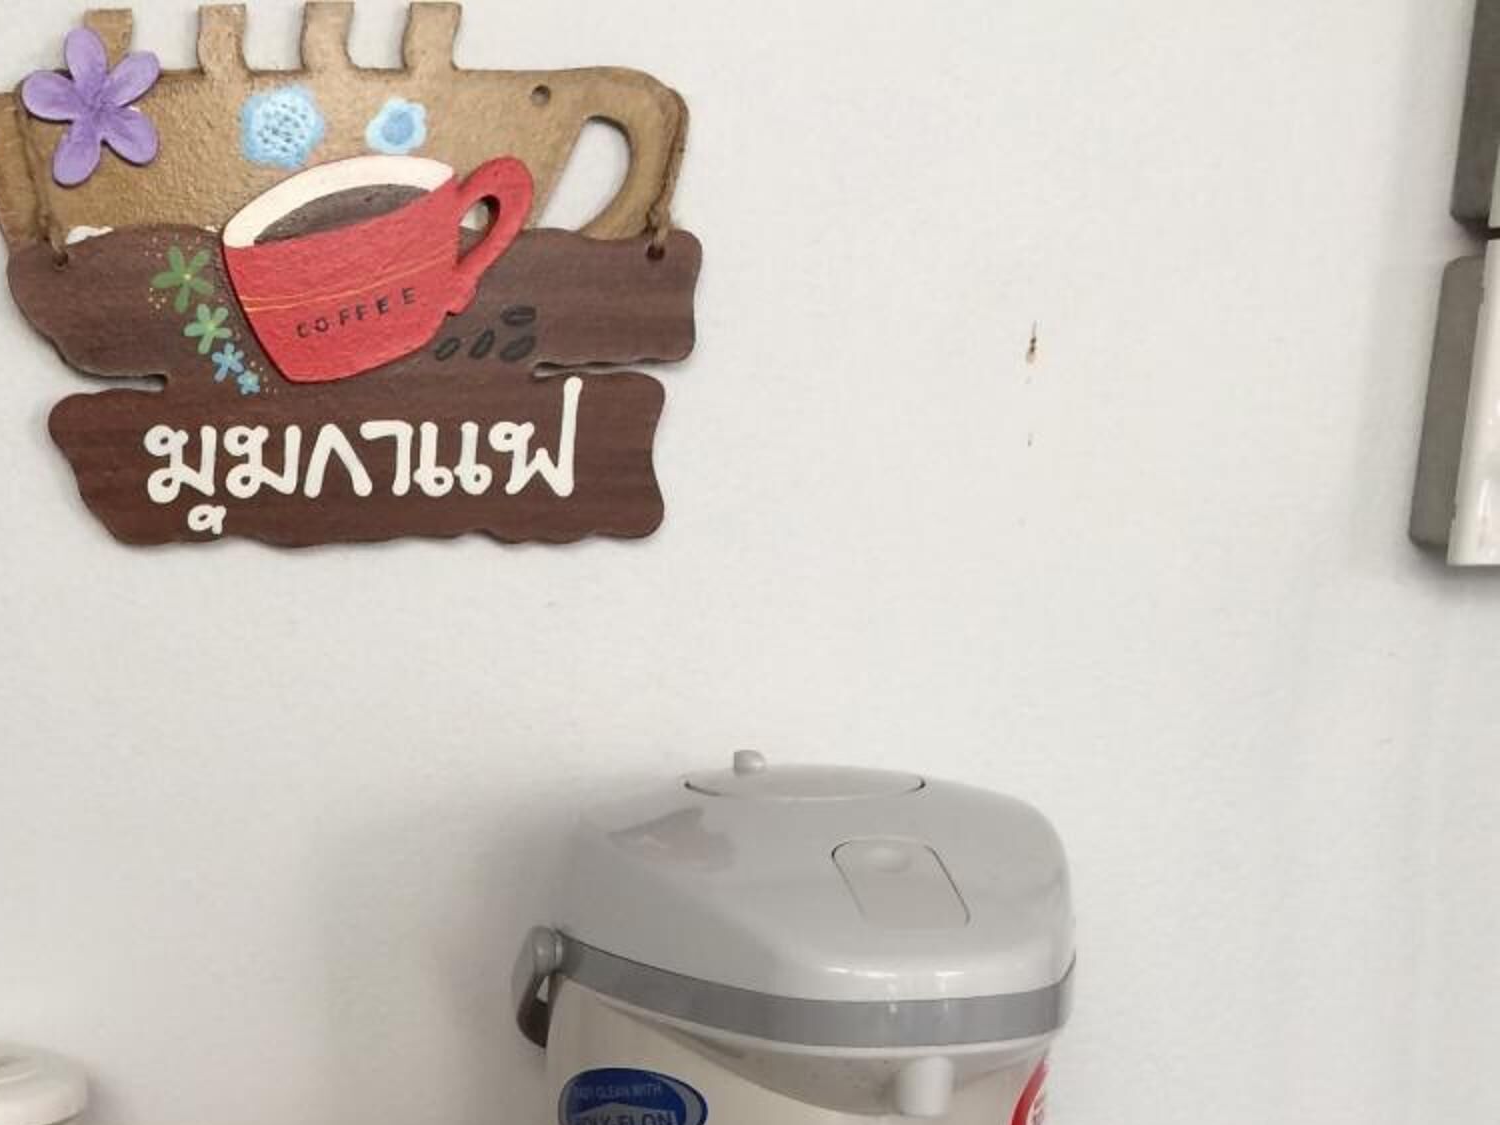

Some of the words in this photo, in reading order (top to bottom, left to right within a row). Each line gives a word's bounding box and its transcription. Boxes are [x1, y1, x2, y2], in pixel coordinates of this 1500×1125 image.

[296, 287, 416, 338] COFFEE
[144, 376, 583, 534] มุมกาแฟ
